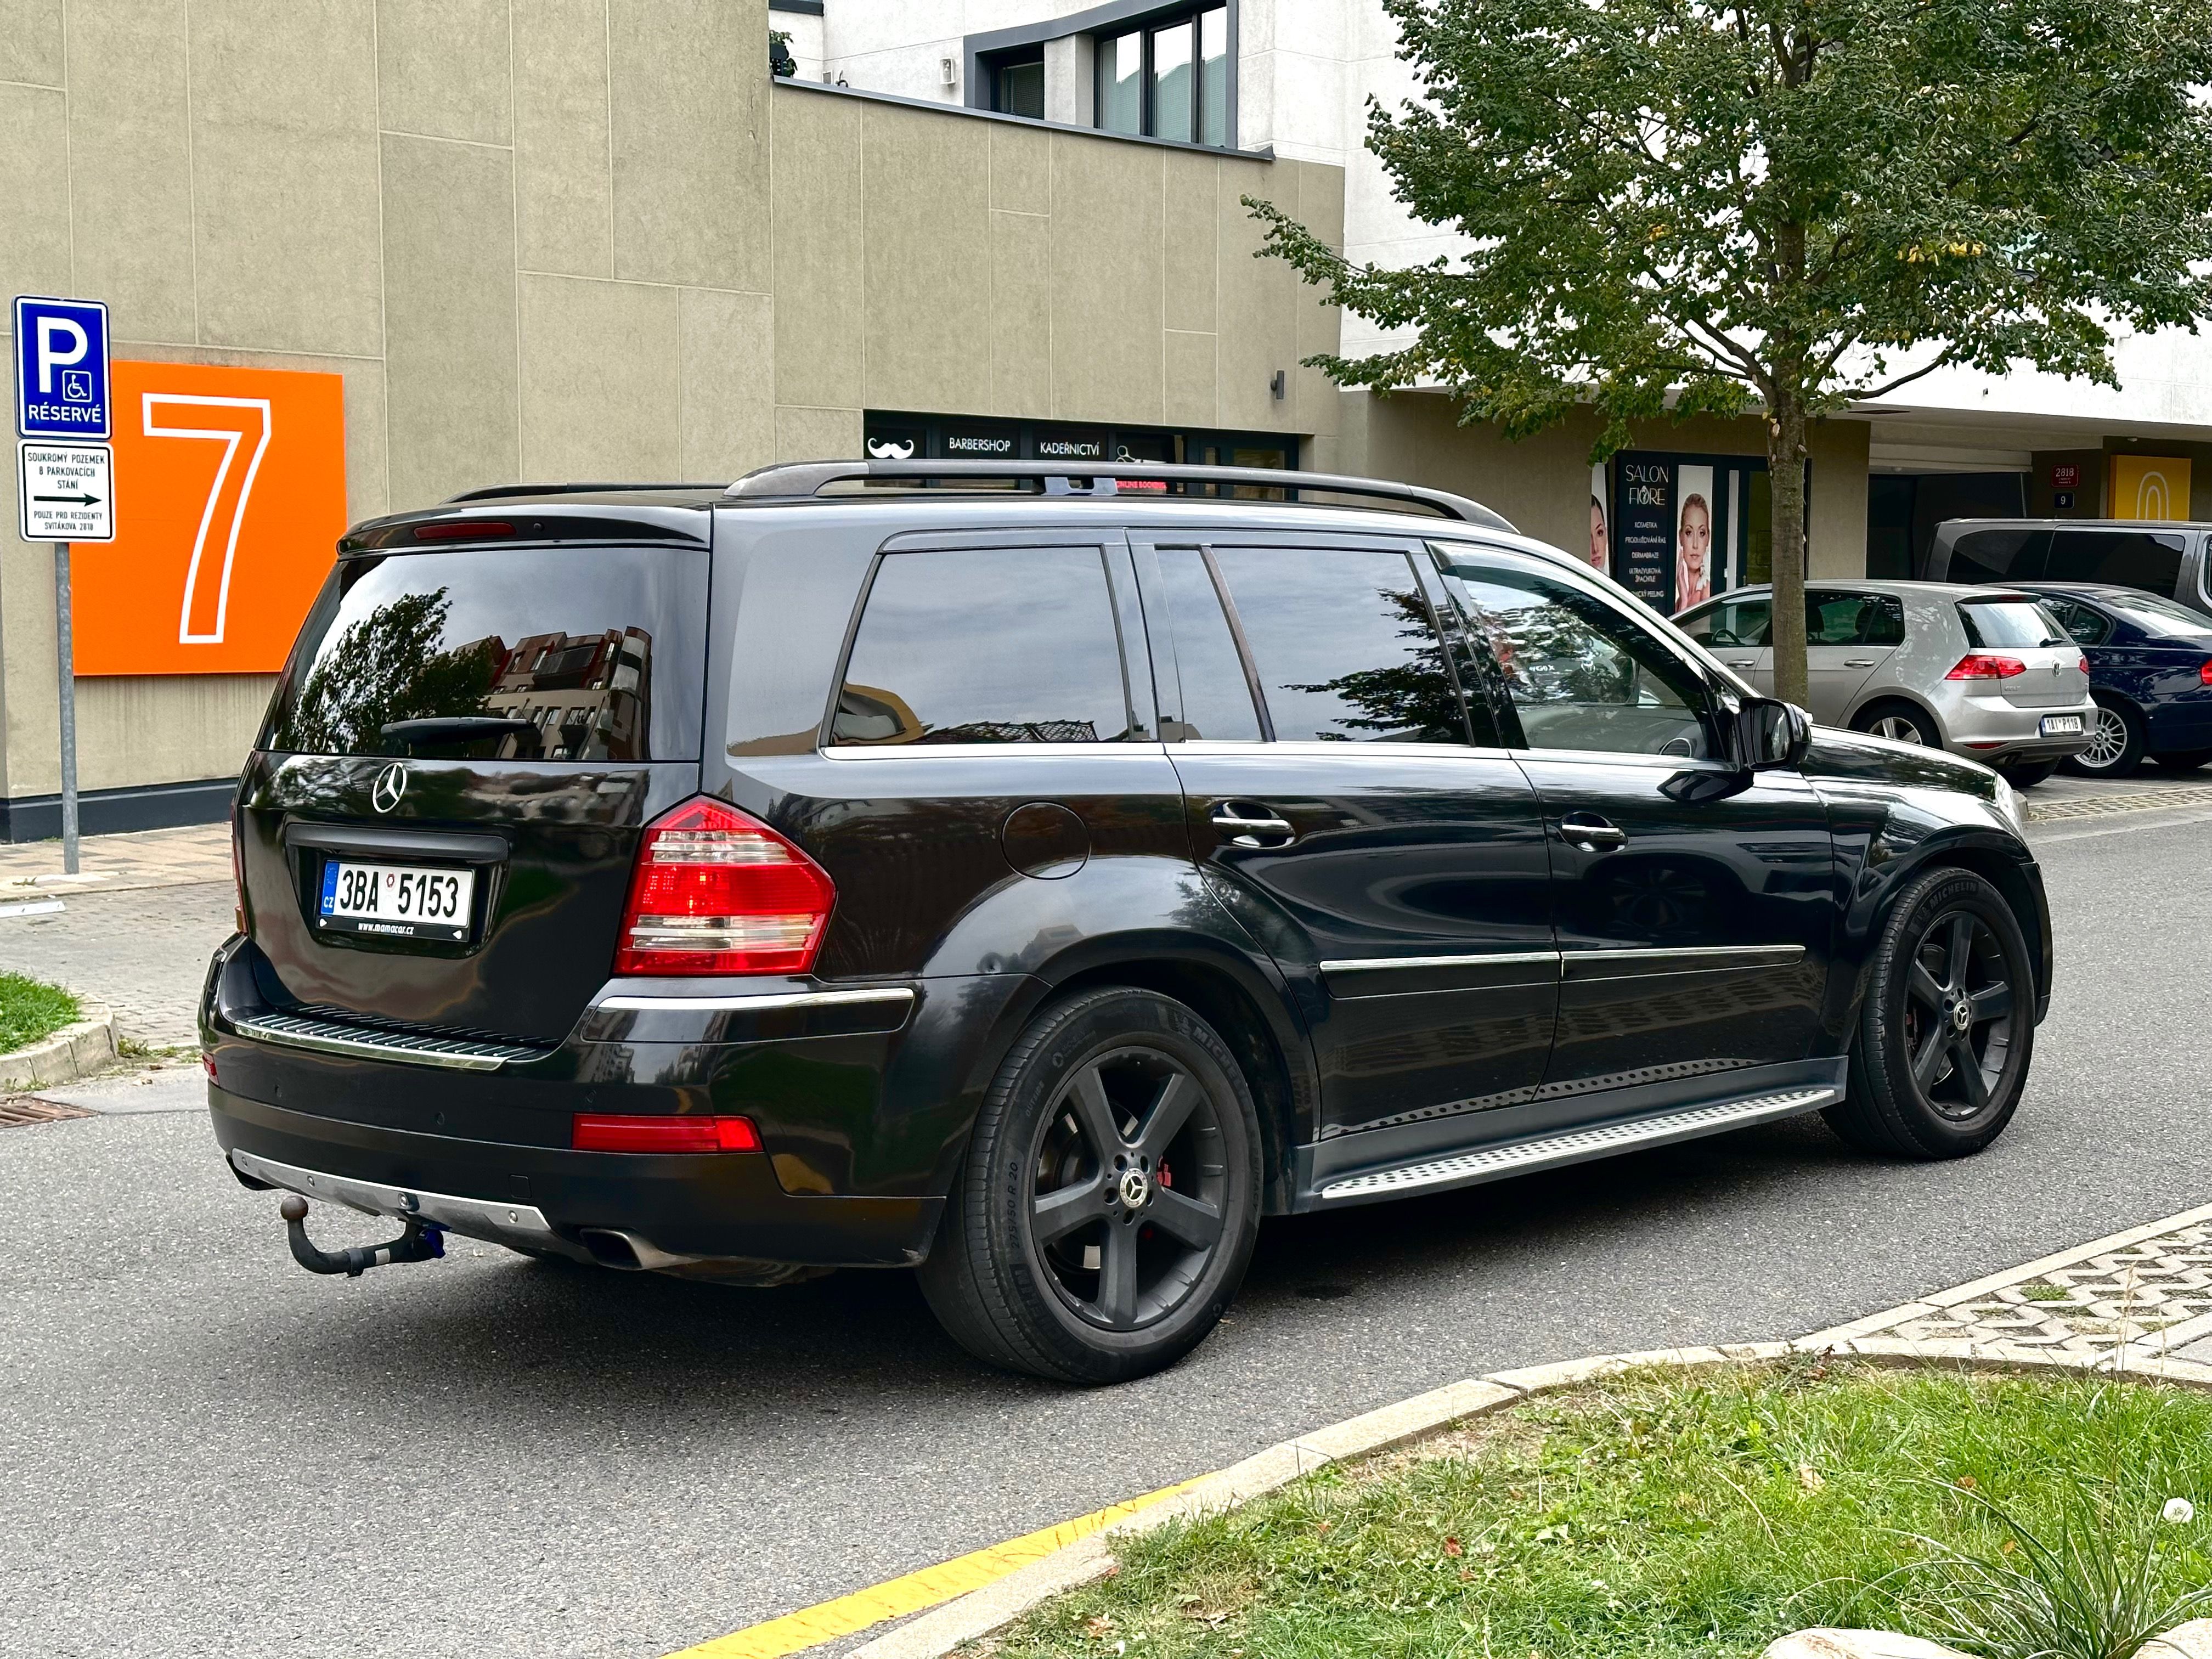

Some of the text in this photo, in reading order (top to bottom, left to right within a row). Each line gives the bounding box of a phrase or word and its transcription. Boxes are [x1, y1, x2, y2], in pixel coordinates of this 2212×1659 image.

[37, 315, 88, 393] P
[29, 401, 101, 423] RÉSERVÉ
[949, 437, 1099, 456] BARBERSHOP KADEŘNICTVÍ
[28, 452, 105, 464] SOUKROMÝ POZEMEK
[47, 465, 95, 477] PARKOVACÍCH
[1626, 465, 1668, 483] SALON
[2056, 468, 2074, 477] 2818
[58, 478, 78, 489] STÁNÍ
[1629, 486, 1666, 505] FIORE
[2061, 495, 2066, 505] 9
[34, 511, 53, 519] POUZE
[71, 512, 103, 520] REZIDENTY
[142, 392, 272, 644] 7
[2062, 718, 2079, 730] P118
[340, 870, 459, 917] 3BA 5153
[324, 896, 334, 909] CZ
[358, 922, 414, 935] www.mamacar.cz
[1008, 1161, 1020, 1250] 275/50 R 20
